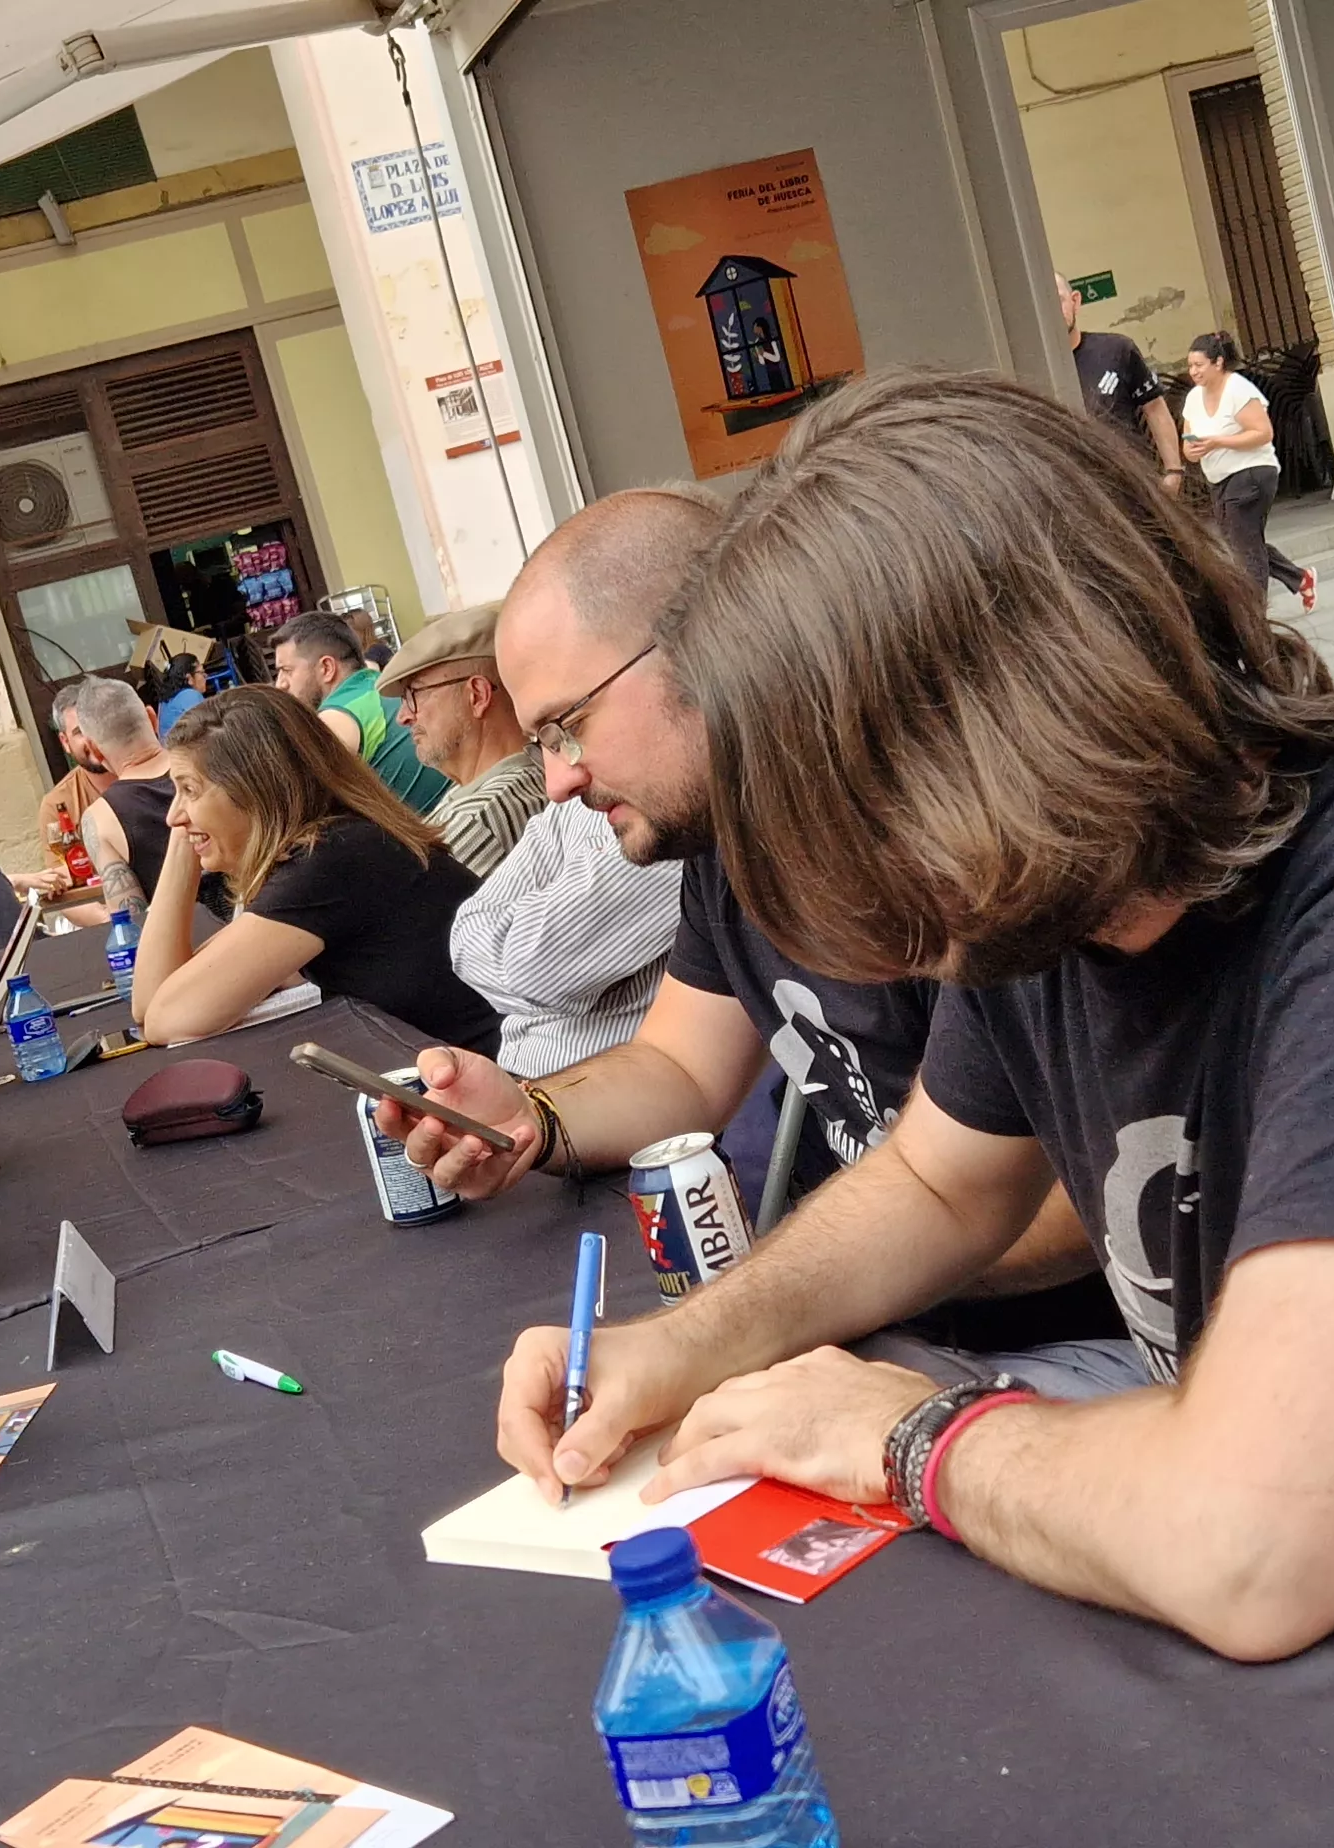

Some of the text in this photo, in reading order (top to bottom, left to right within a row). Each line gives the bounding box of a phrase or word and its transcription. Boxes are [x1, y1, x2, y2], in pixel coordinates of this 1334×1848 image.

[433, 154, 450, 168] DE
[727, 174, 809, 201] FERIA DEL LIBRO
[757, 195, 771, 206] DE
[773, 187, 812, 203] HUESCA
